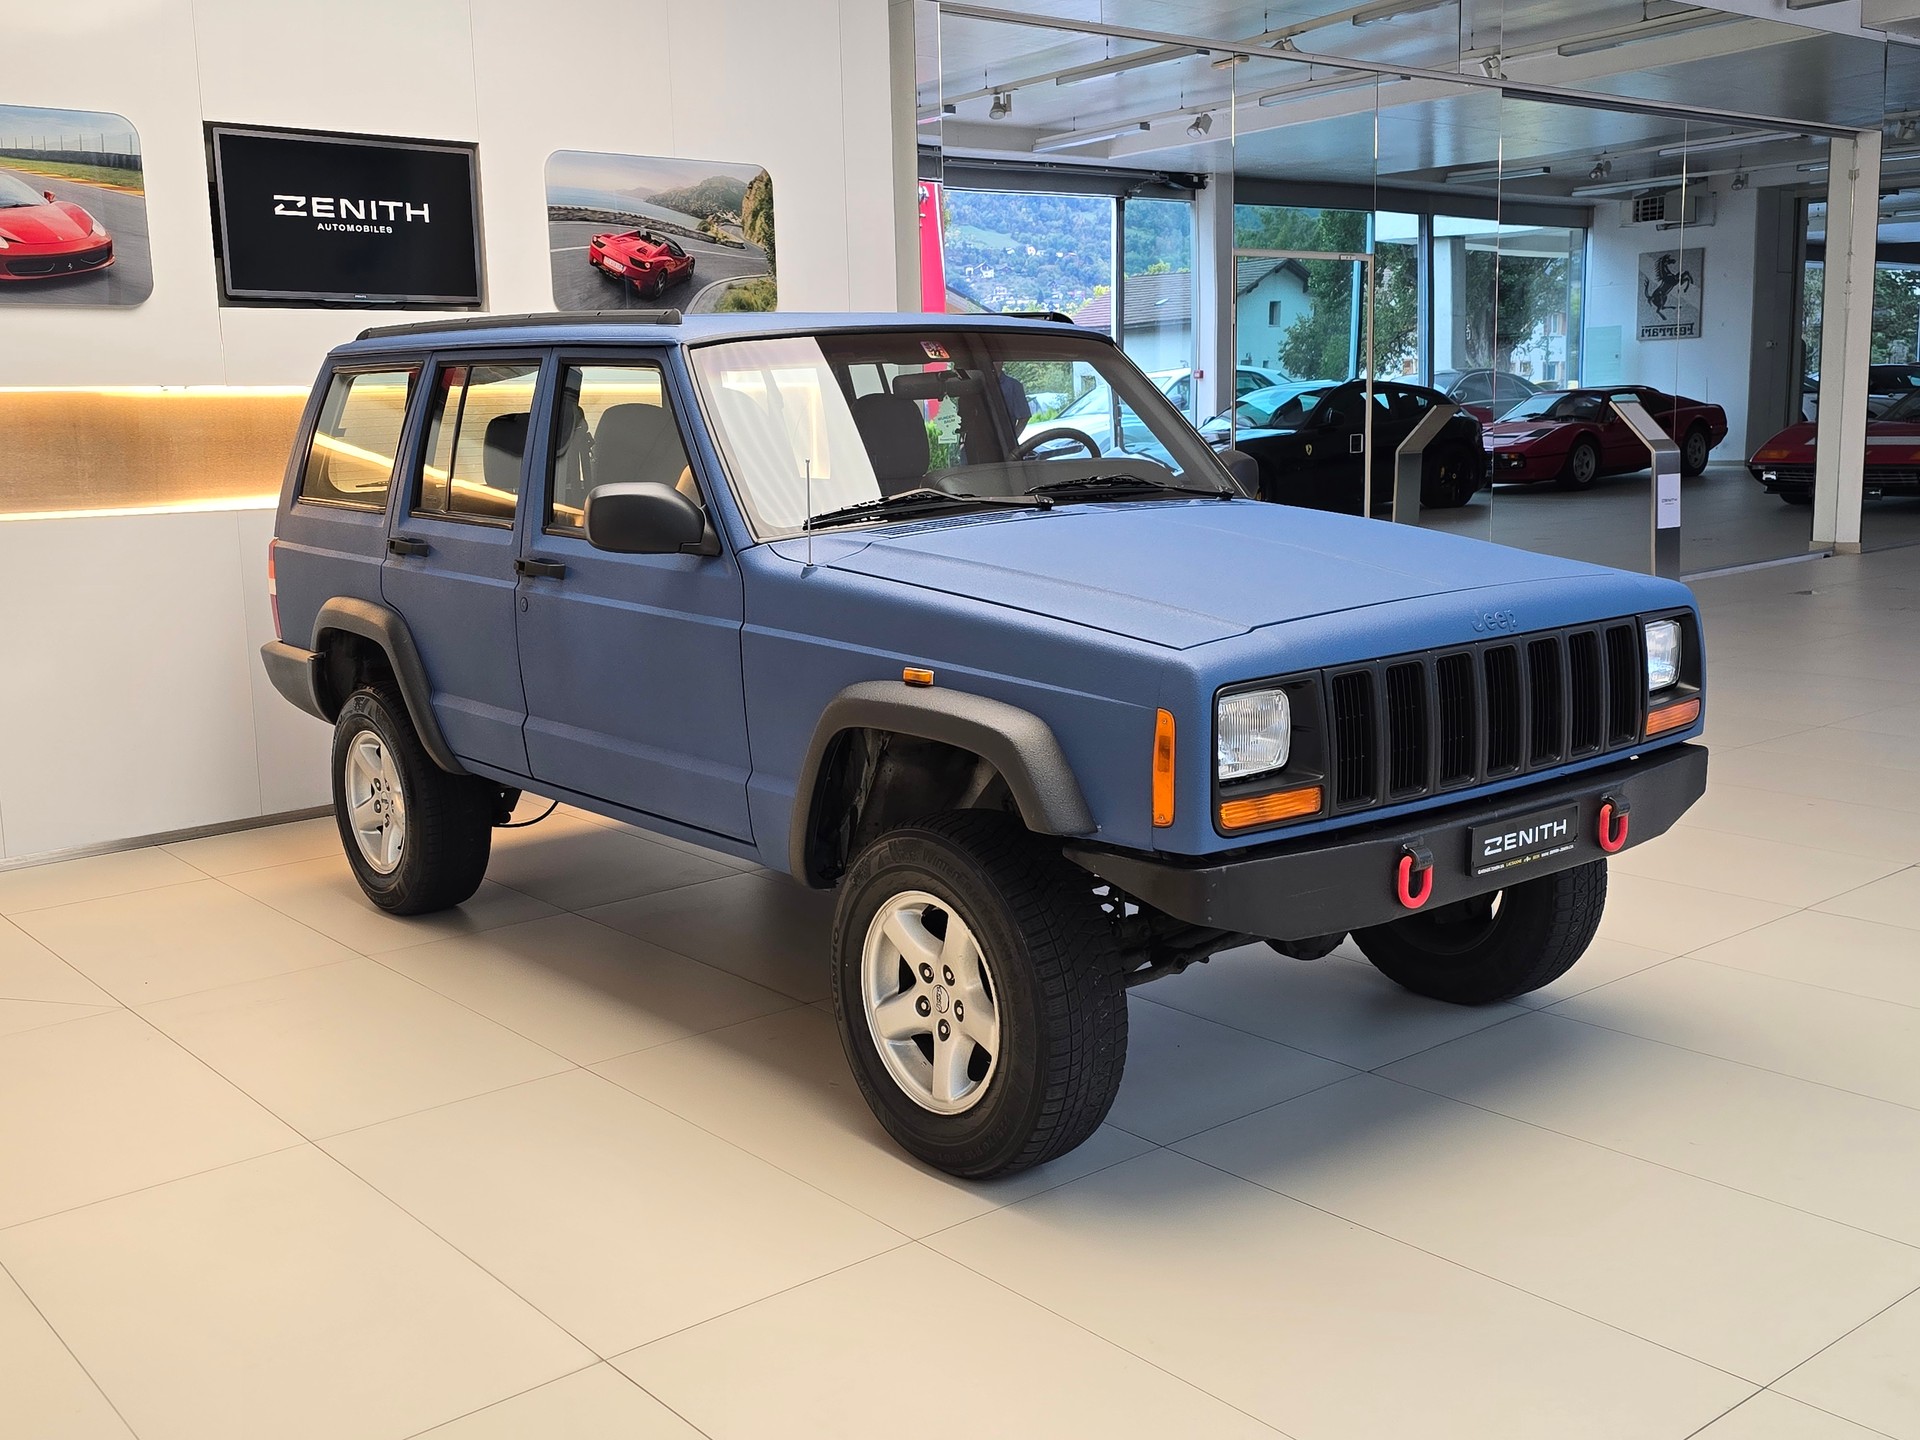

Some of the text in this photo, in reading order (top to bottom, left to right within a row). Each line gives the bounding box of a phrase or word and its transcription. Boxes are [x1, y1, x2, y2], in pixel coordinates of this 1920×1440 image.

[273, 194, 430, 223] ZENITH
[317, 222, 393, 234] AUTOMOBILES
[1470, 609, 1518, 633] Jeep
[1484, 818, 1567, 857] ZENITH
